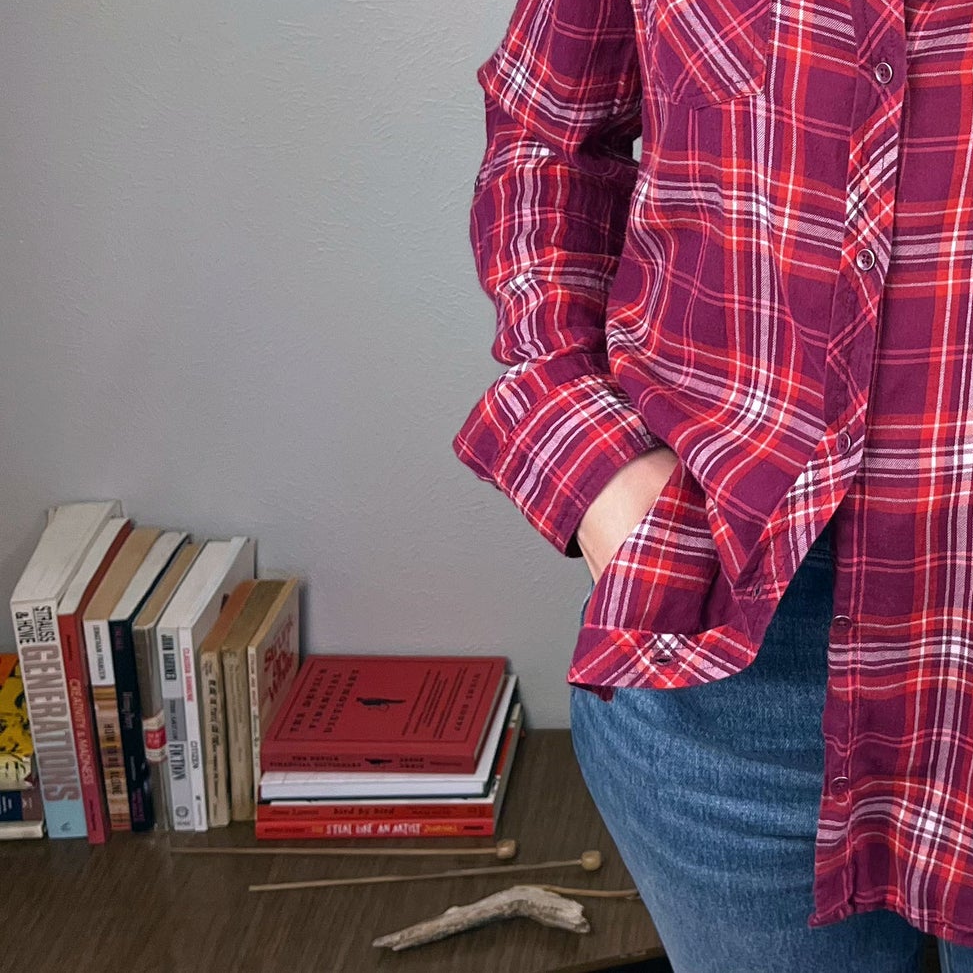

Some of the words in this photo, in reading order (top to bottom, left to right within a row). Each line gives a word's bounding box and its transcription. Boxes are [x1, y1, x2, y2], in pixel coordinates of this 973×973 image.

[34, 605, 56, 642] STRAUSS
[161, 634, 174, 651] JOHN
[182, 647, 193, 674] CLAUDIA
[68, 678, 87, 731] CREATIVITY
[20, 644, 81, 802] GENERATIONS
[104, 723, 115, 743] HOW
[76, 738, 94, 785] MADNESS
[169, 743, 186, 781] FICTION
[190, 740, 200, 770] CITIZEN
[109, 770, 122, 796] ALONE
[326, 823, 352, 835] STEAL
[377, 823, 391, 834] AN
[391, 823, 421, 835] ARTIST
